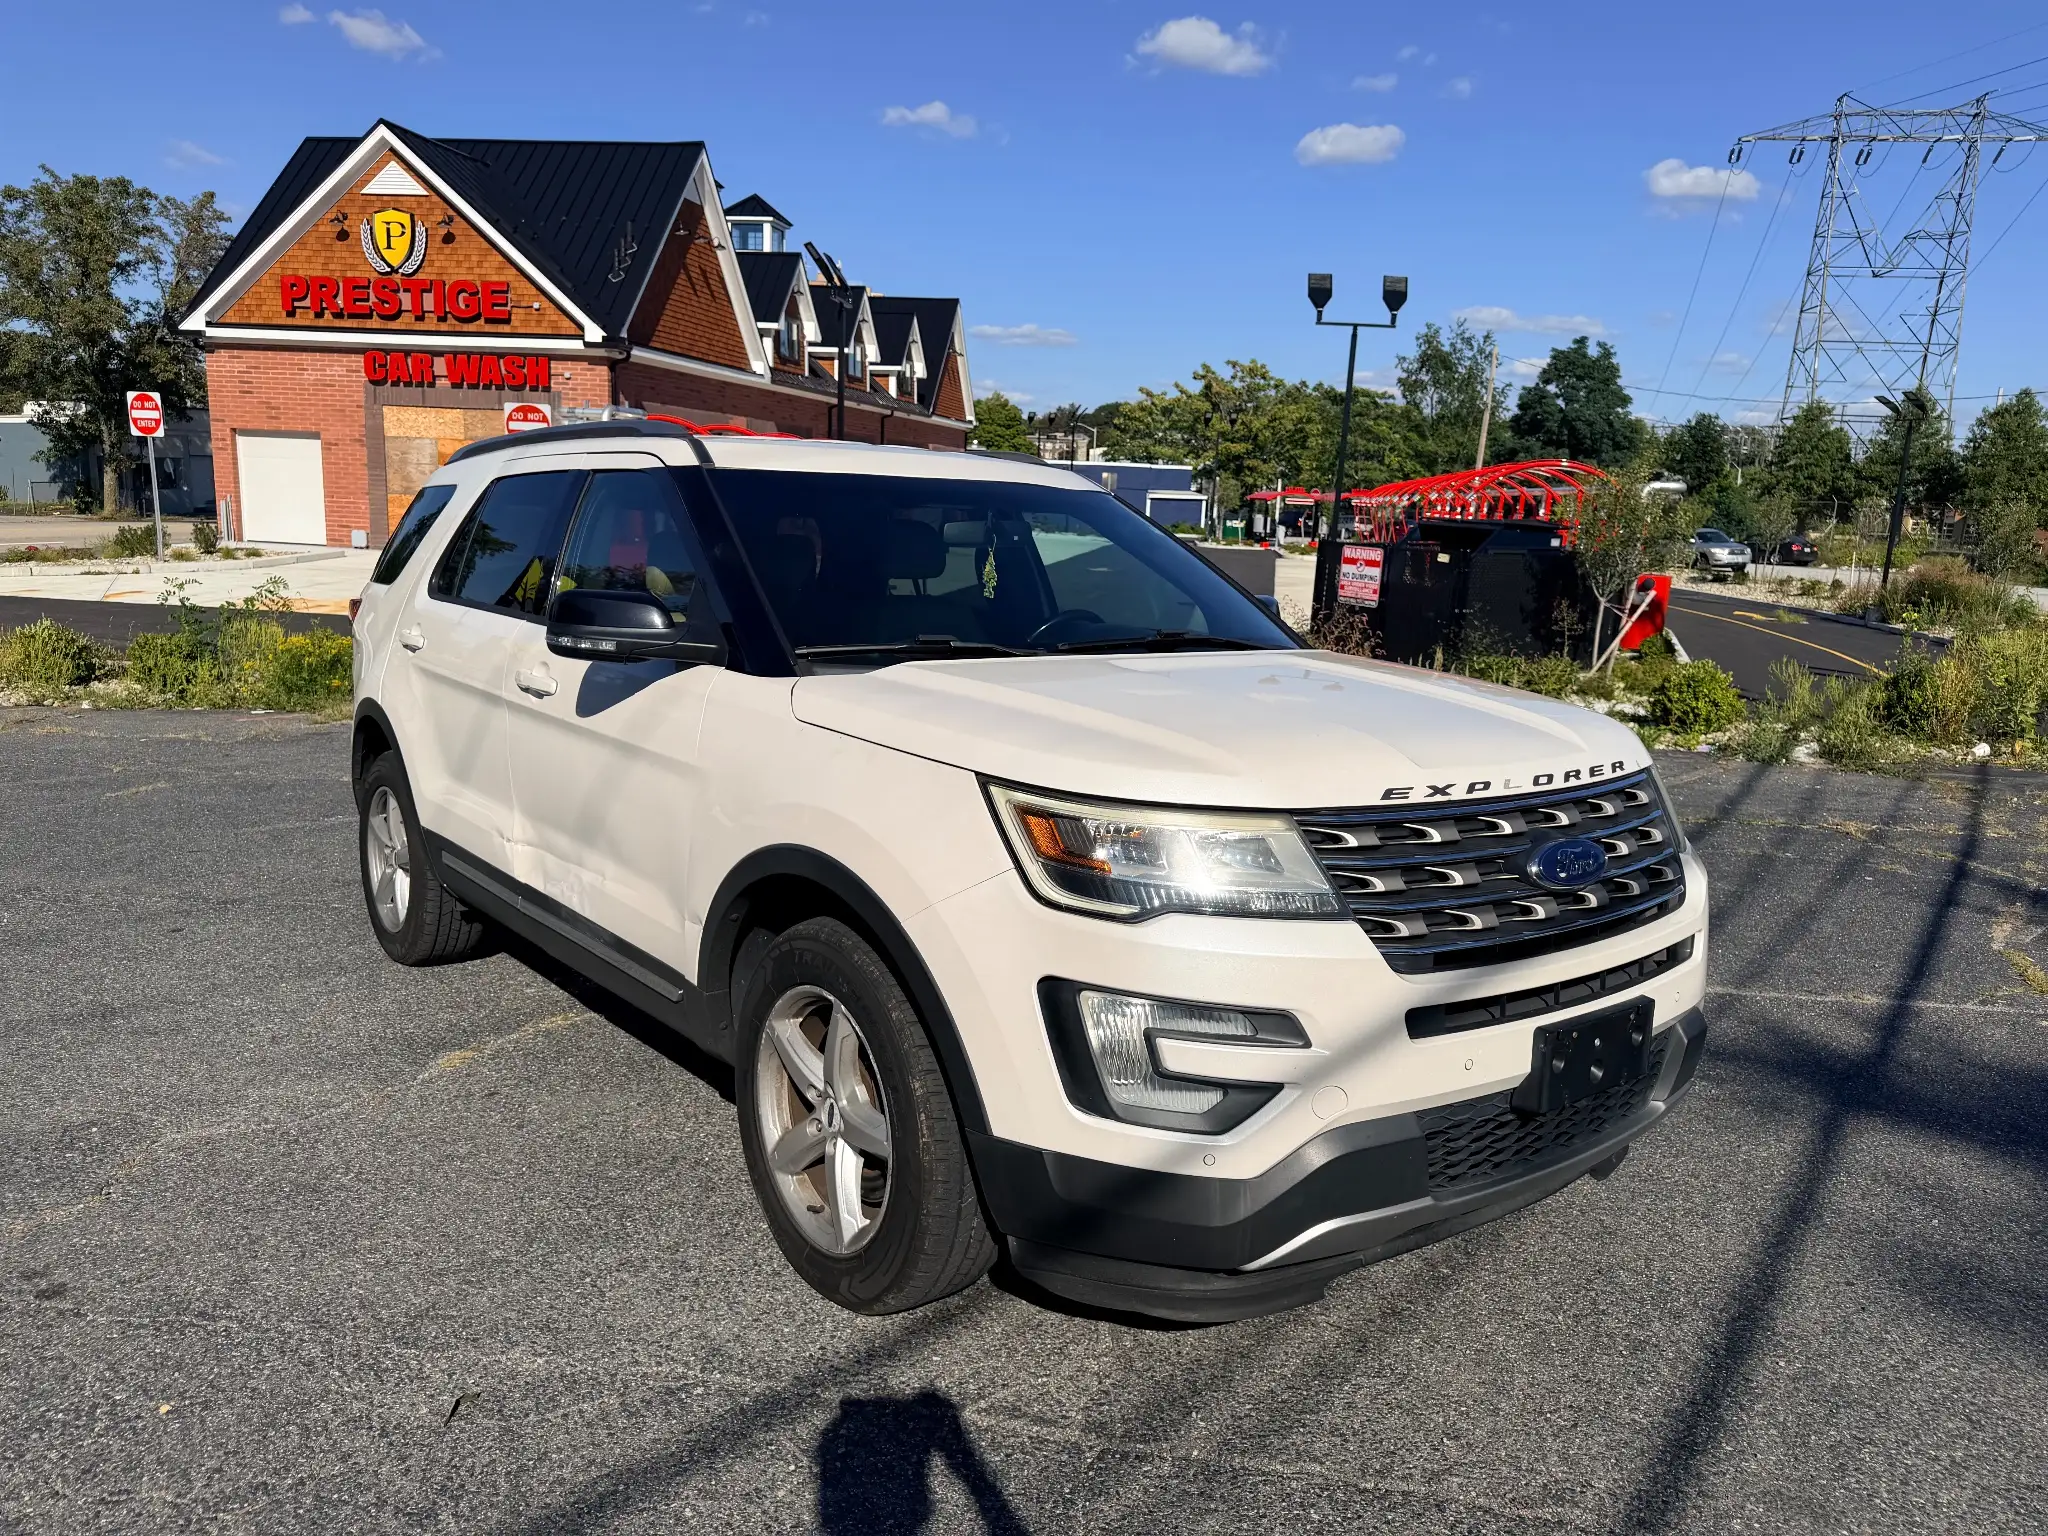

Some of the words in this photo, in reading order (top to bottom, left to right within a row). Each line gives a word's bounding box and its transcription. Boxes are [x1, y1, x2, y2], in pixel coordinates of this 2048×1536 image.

[382, 220, 407, 250] P
[280, 275, 511, 322] PRESTIGE
[363, 351, 435, 384] CAR
[444, 353, 550, 388] WASH
[137, 420, 156, 428] ENTER
[512, 412, 524, 420] DO
[527, 412, 544, 421] NOT
[1344, 547, 1381, 562] WARNING
[1342, 572, 1350, 580] NO
[1351, 572, 1378, 583] DUMPING
[1380, 760, 1626, 801] EXPLORER
[1556, 846, 1597, 879] Ford
